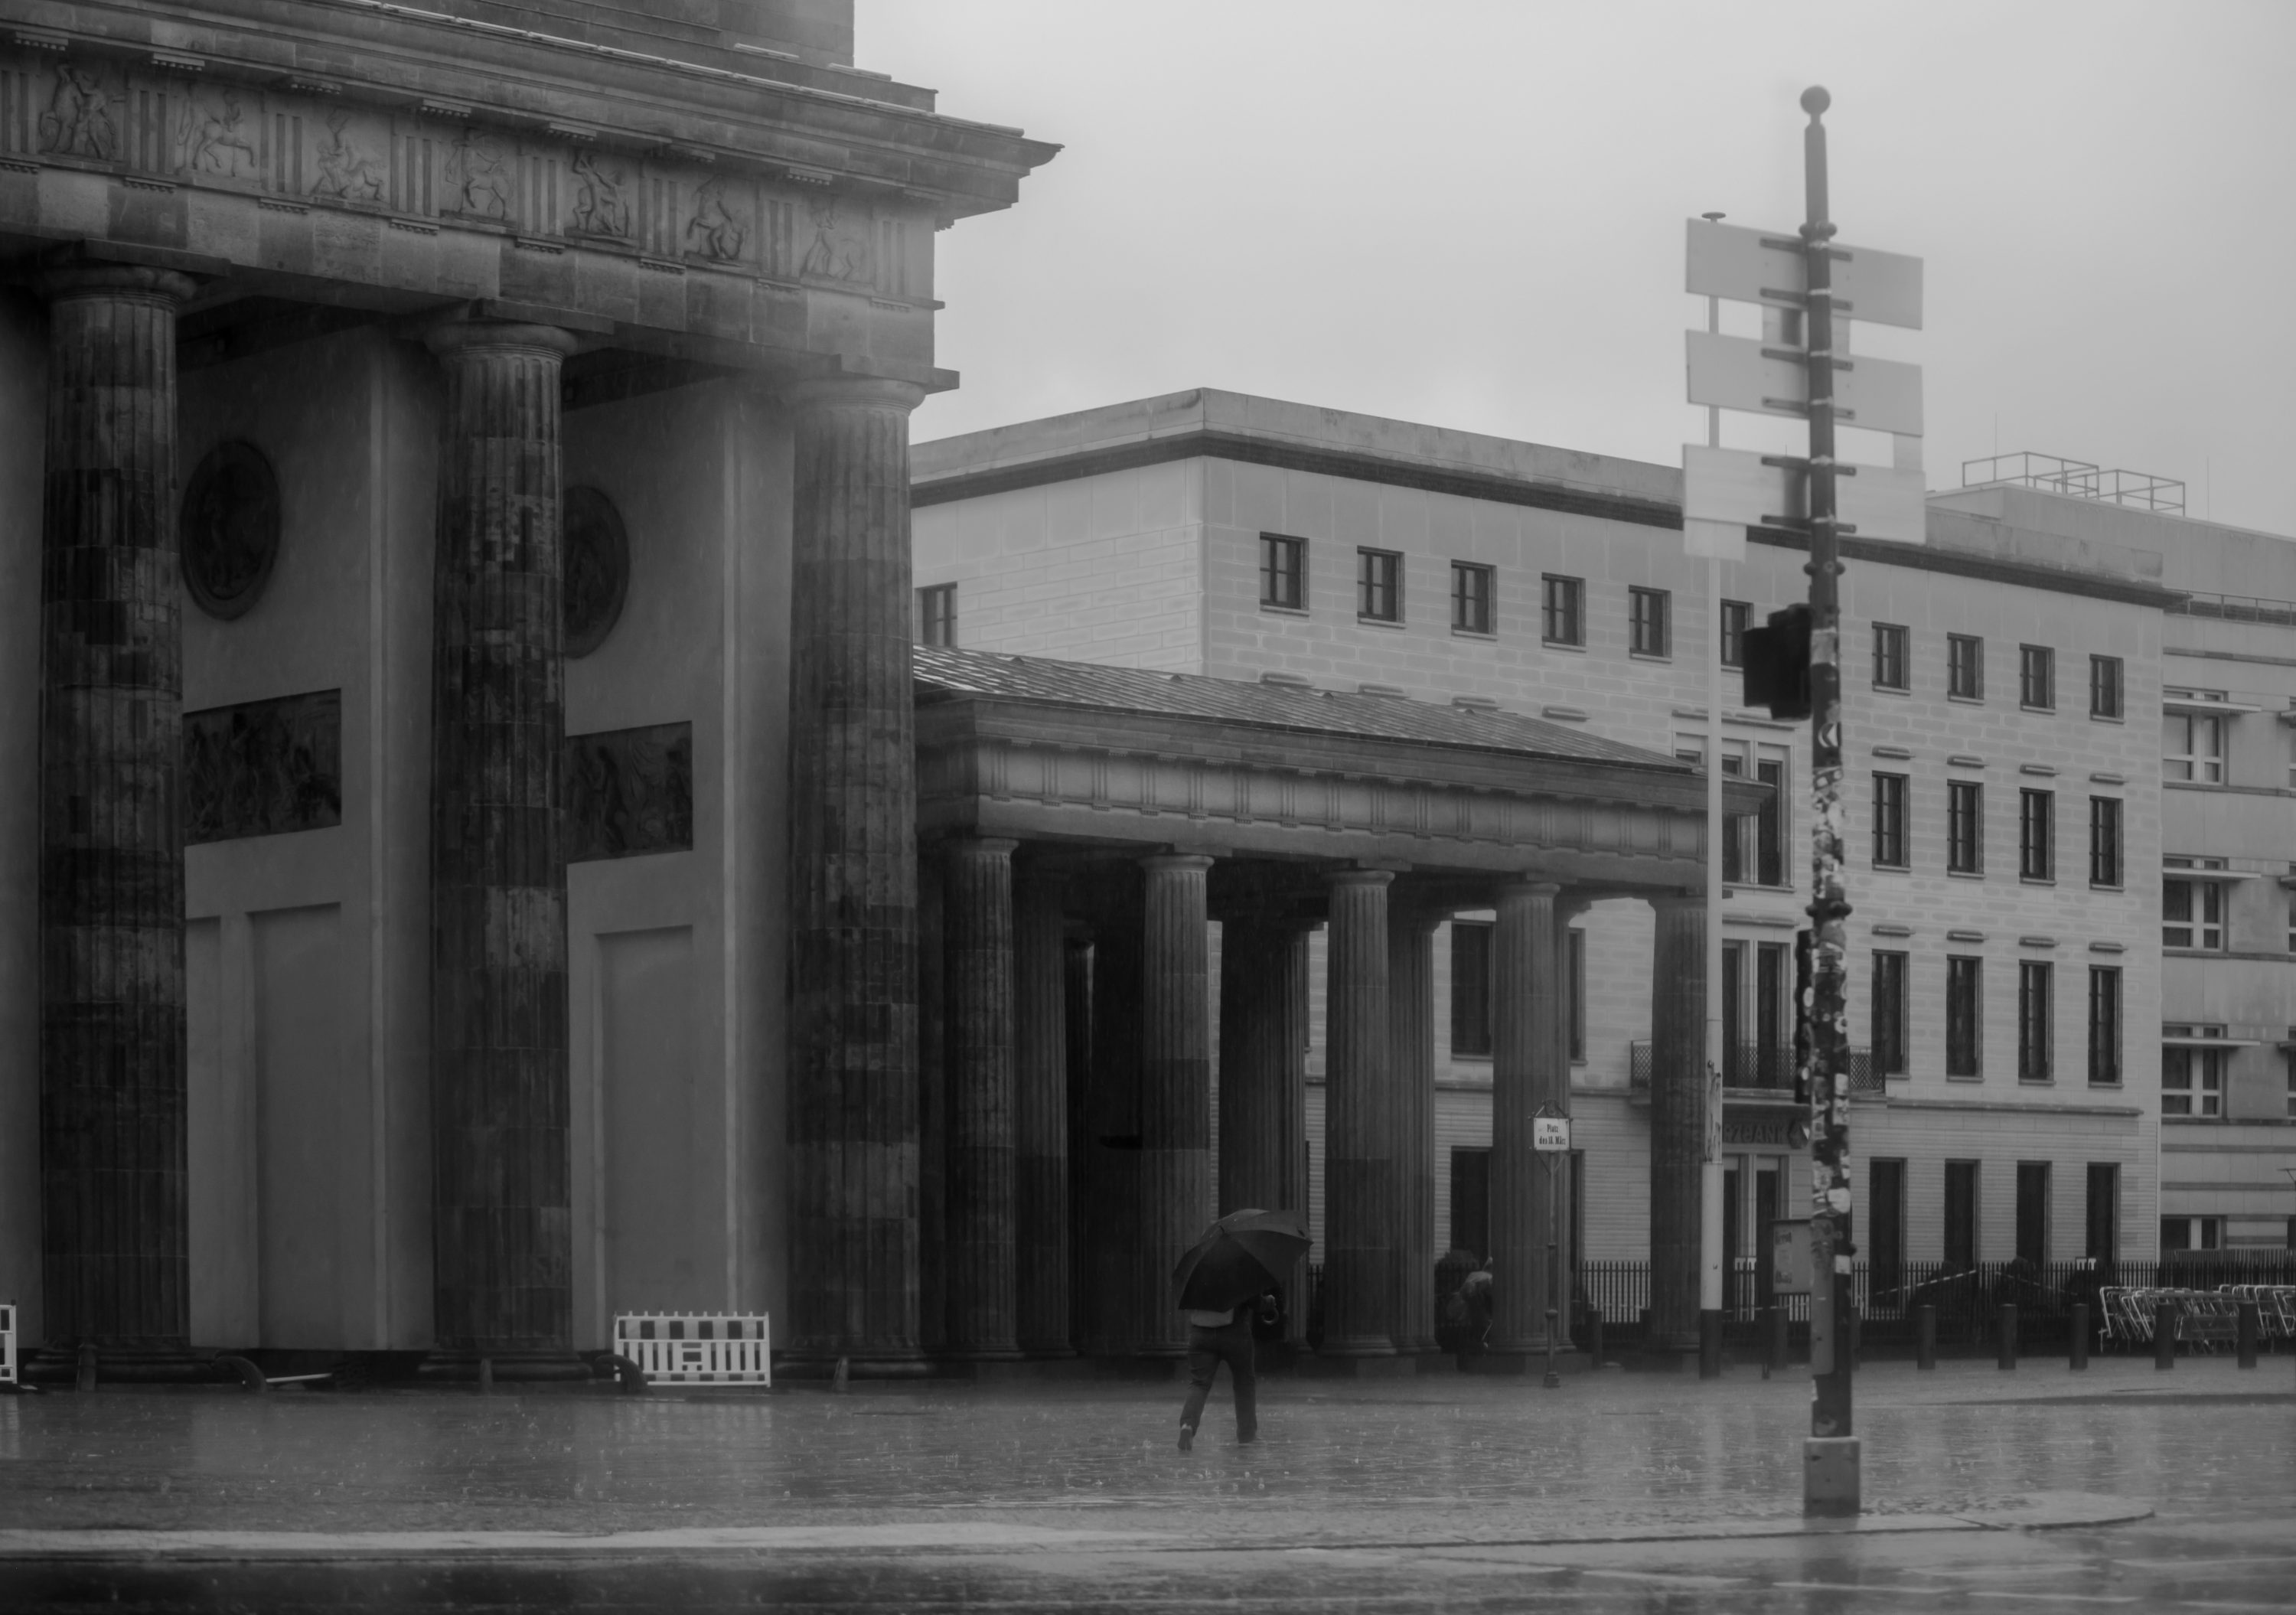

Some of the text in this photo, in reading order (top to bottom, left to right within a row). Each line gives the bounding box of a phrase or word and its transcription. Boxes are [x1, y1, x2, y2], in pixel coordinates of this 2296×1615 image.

[1547, 1124, 1558, 1133] Platz
[1539, 1136, 1548, 1144] des
[1555, 1136, 1566, 1144] März
